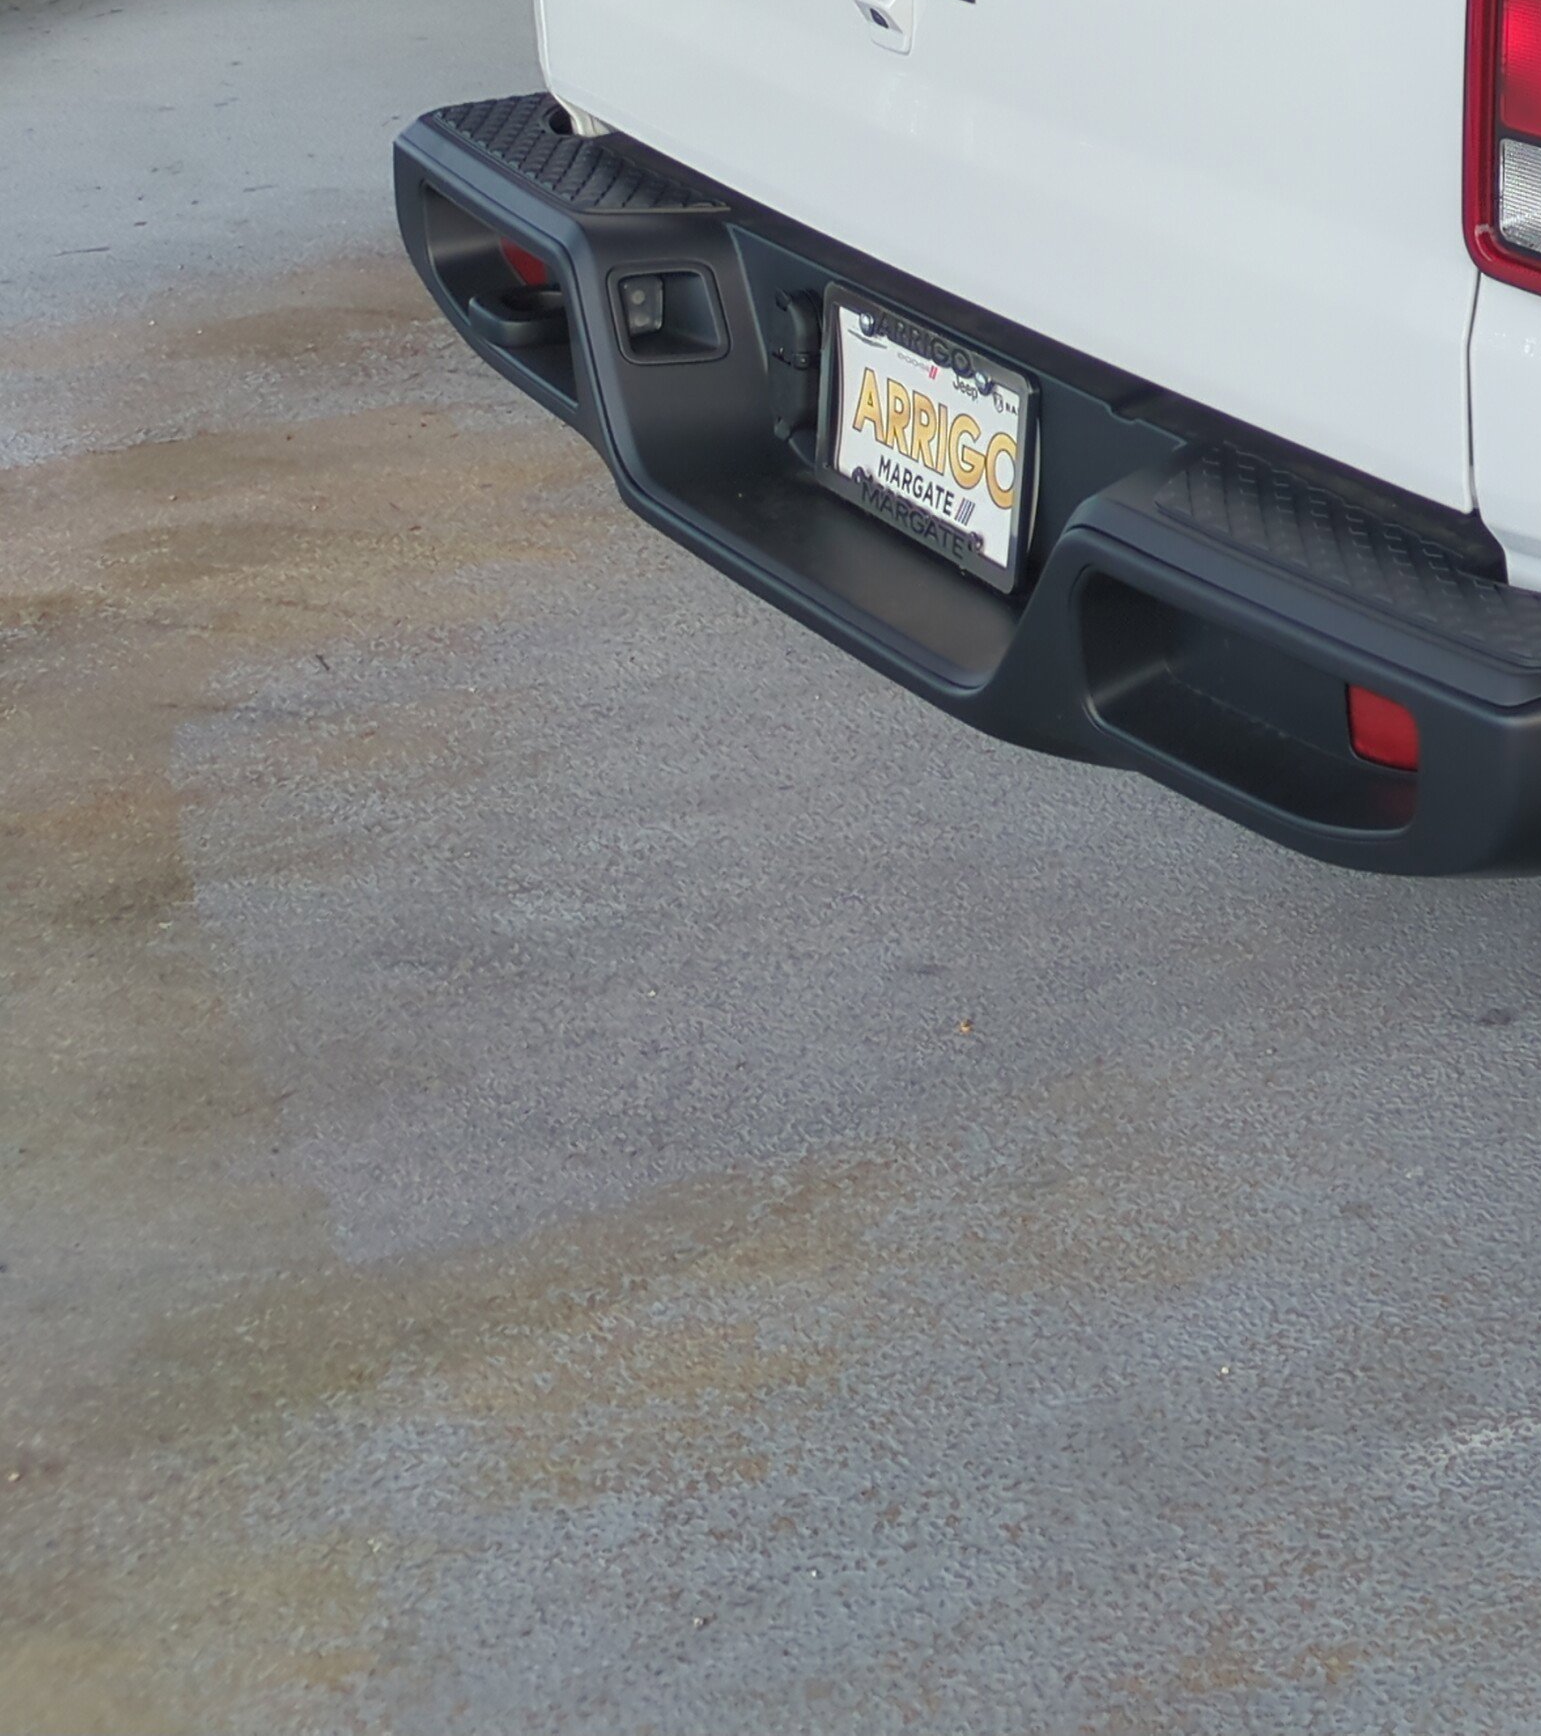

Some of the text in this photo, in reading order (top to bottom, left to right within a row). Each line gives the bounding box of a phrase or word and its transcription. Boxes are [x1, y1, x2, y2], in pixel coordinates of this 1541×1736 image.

[874, 311, 976, 379] ARRIGO
[953, 373, 978, 401] Jeep
[852, 366, 1018, 510] ARRIGO
[877, 454, 955, 516] MARGATE
[859, 481, 966, 559] MARGATE
